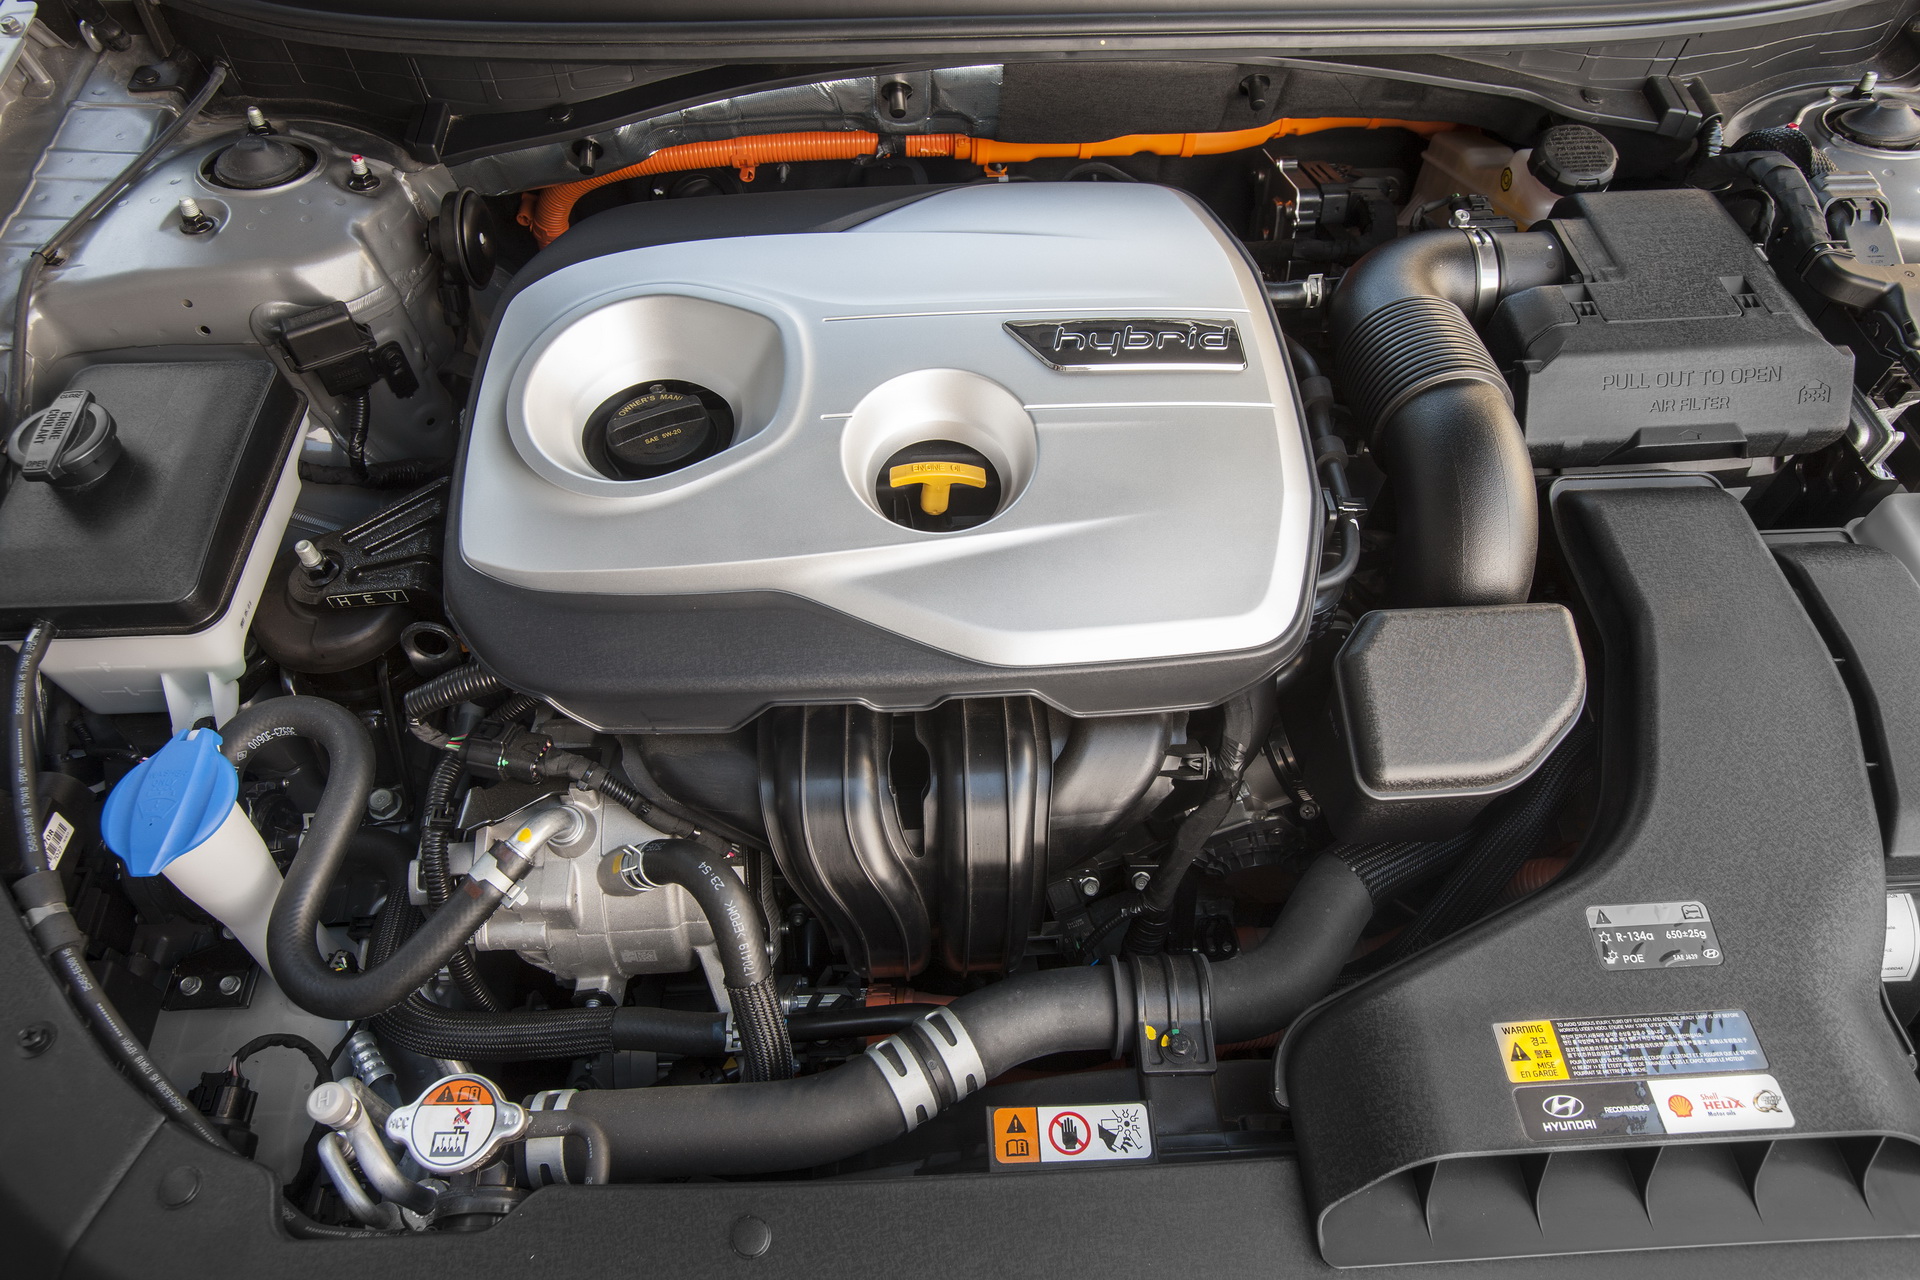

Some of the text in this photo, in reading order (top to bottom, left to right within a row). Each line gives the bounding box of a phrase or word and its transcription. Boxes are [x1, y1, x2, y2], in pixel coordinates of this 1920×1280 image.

[1053, 324, 1231, 357] hybrid
[1602, 365, 1782, 391] PULL OUT TO OPEN
[618, 395, 656, 417] OWNER'S
[1649, 396, 1730, 413] AIR FILTER
[645, 428, 682, 445] SAE 5W-20
[911, 463, 966, 473] ENGINE OIL
[336, 592, 397, 607] HEV
[698, 861, 726, 891] 23:54
[1615, 928, 1707, 942] R-134a 650±25g
[739, 942, 757, 976] 170419
[1622, 953, 1645, 964] POE
[1501, 1024, 1544, 1035] WARNING
[1530, 1036, 1548, 1047] 경고
[1537, 1061, 1557, 1070] MISE
[1532, 1069, 1559, 1078] GARDE
[317, 1090, 330, 1108] H
[1700, 1092, 1719, 1101] Shell
[1603, 1104, 1650, 1114] RECOMMENDS
[1703, 1098, 1746, 1110] HELIX
[1542, 1119, 1597, 1132] HYUNDAI
